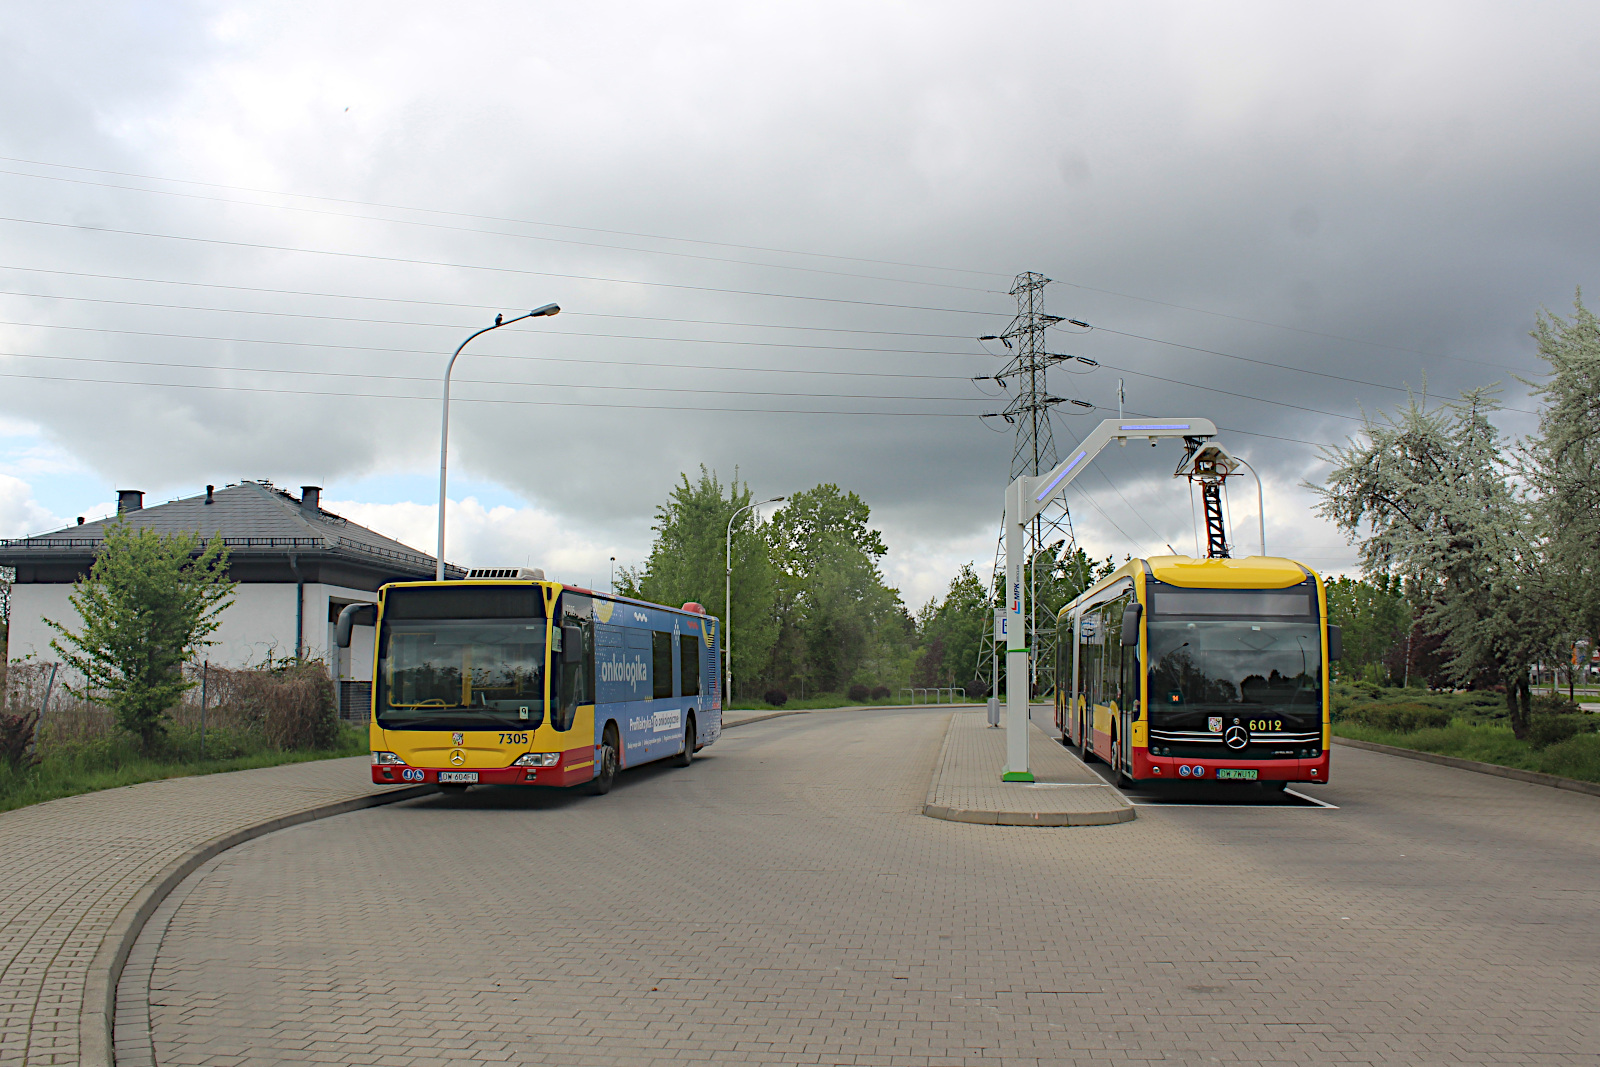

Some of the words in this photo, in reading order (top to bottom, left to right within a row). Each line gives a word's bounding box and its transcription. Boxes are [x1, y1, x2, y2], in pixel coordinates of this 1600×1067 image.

[601, 653, 647, 693] onkologika
[1249, 719, 1282, 731] 6012
[498, 733, 528, 744] 7305
[442, 772, 452, 780] DW
[454, 772, 477, 781] 604FU
[1220, 769, 1231, 778] DW
[1233, 769, 1256, 779] 7WU12
